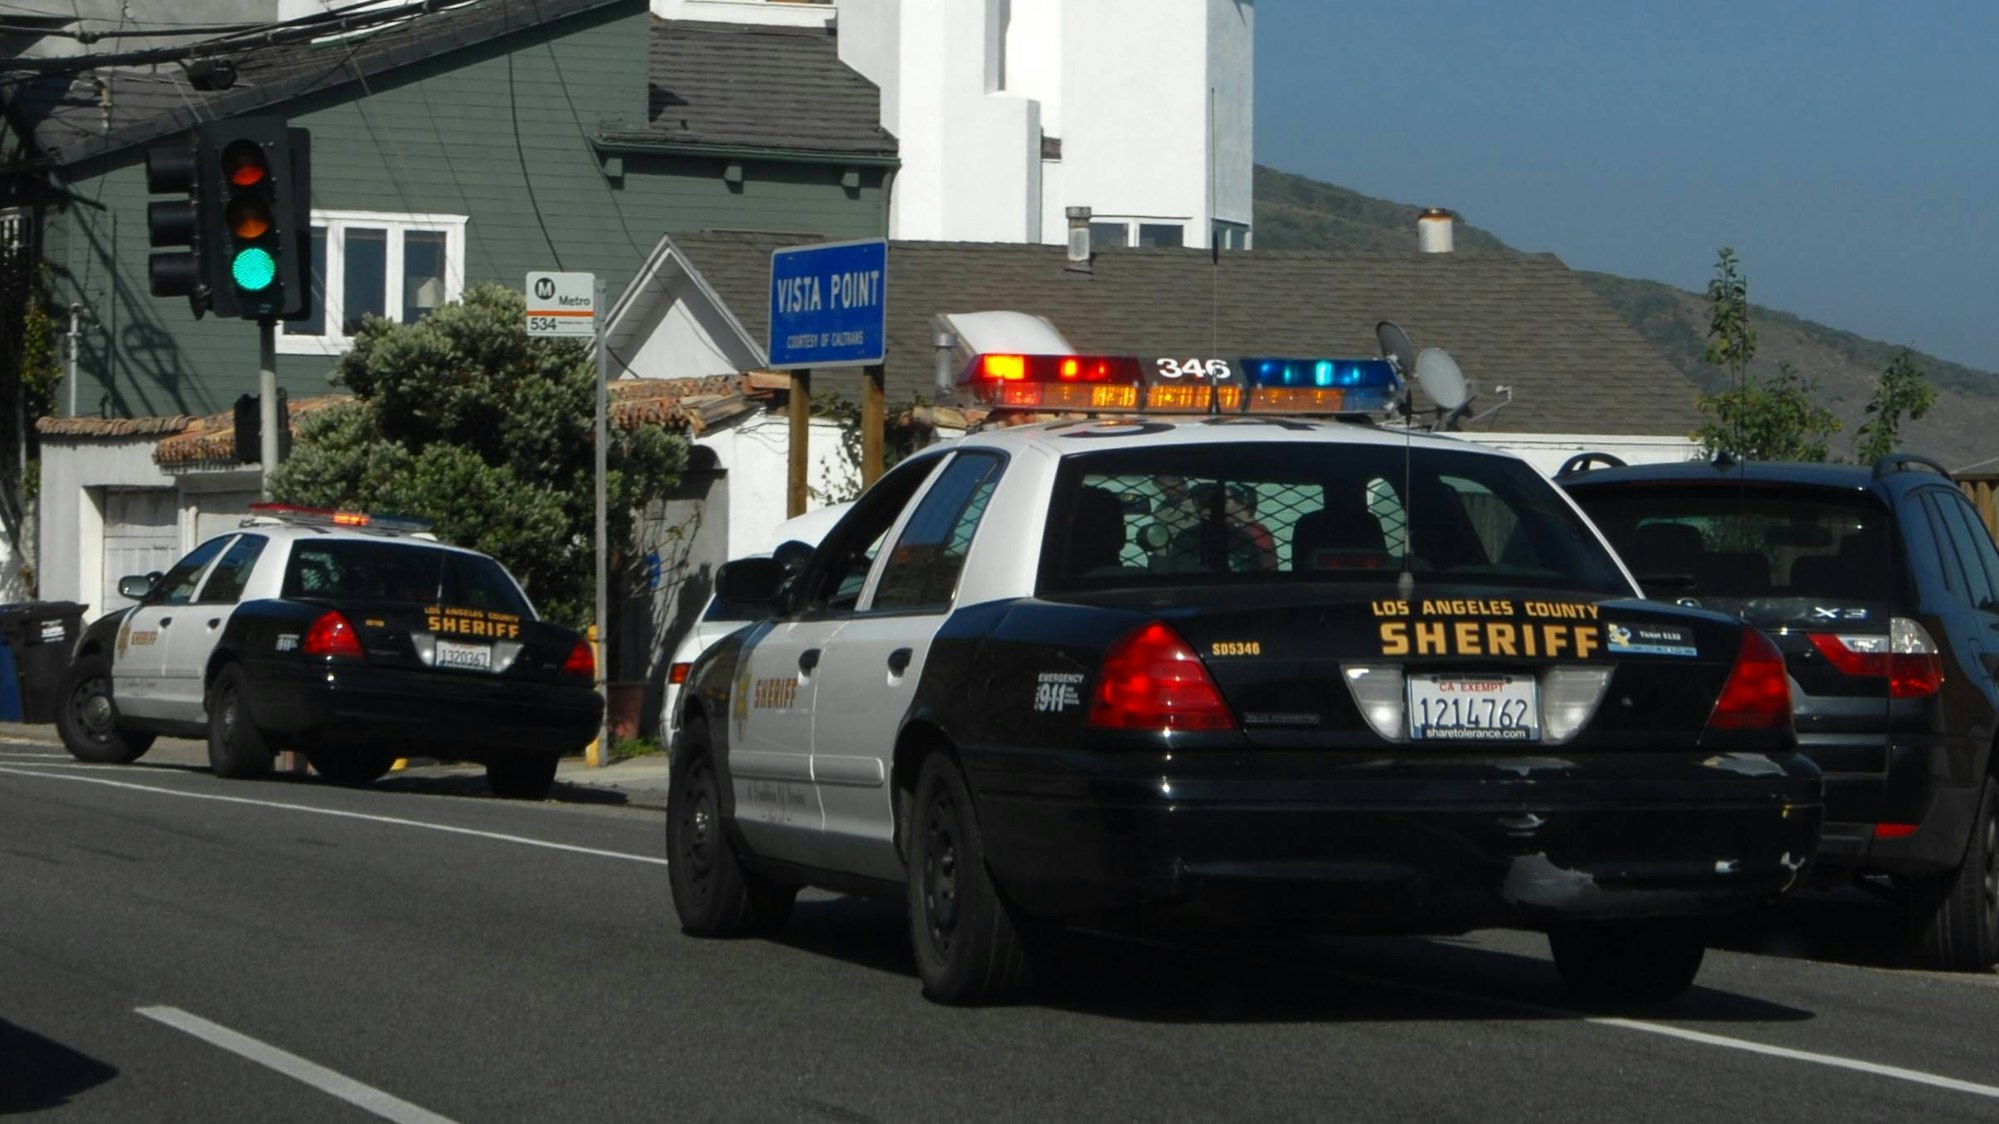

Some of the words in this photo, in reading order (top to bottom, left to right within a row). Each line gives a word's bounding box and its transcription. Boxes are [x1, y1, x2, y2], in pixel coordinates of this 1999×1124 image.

[537, 280, 553, 298] M
[778, 276, 821, 313] VISTA
[830, 270, 879, 309] POINT
[559, 296, 590, 306] Metro
[530, 317, 557, 331] 534
[787, 334, 818, 349] COURTESY
[821, 333, 830, 347] OF
[831, 331, 863, 347] CALTRANS
[1156, 358, 1231, 379] 346
[424, 606, 441, 614] LOS
[445, 607, 484, 617] ANGELES
[488, 611, 520, 623] COUNTY
[1372, 600, 1410, 616] LOS
[1423, 600, 1514, 616] ANGELES
[1525, 602, 1598, 620] COUNTY
[428, 616, 520, 639] SHERIFF
[1380, 622, 1598, 658] SHERIFF
[1038, 673, 1085, 684] EMERGENCY
[1439, 682, 1455, 692] CA
[1461, 682, 1505, 692] EXEMPT
[754, 678, 798, 709] SHERIFF
[1038, 683, 1066, 712] 911
[1420, 698, 1528, 728] 1214762
[1426, 728, 1526, 739] sharetolerance.com
